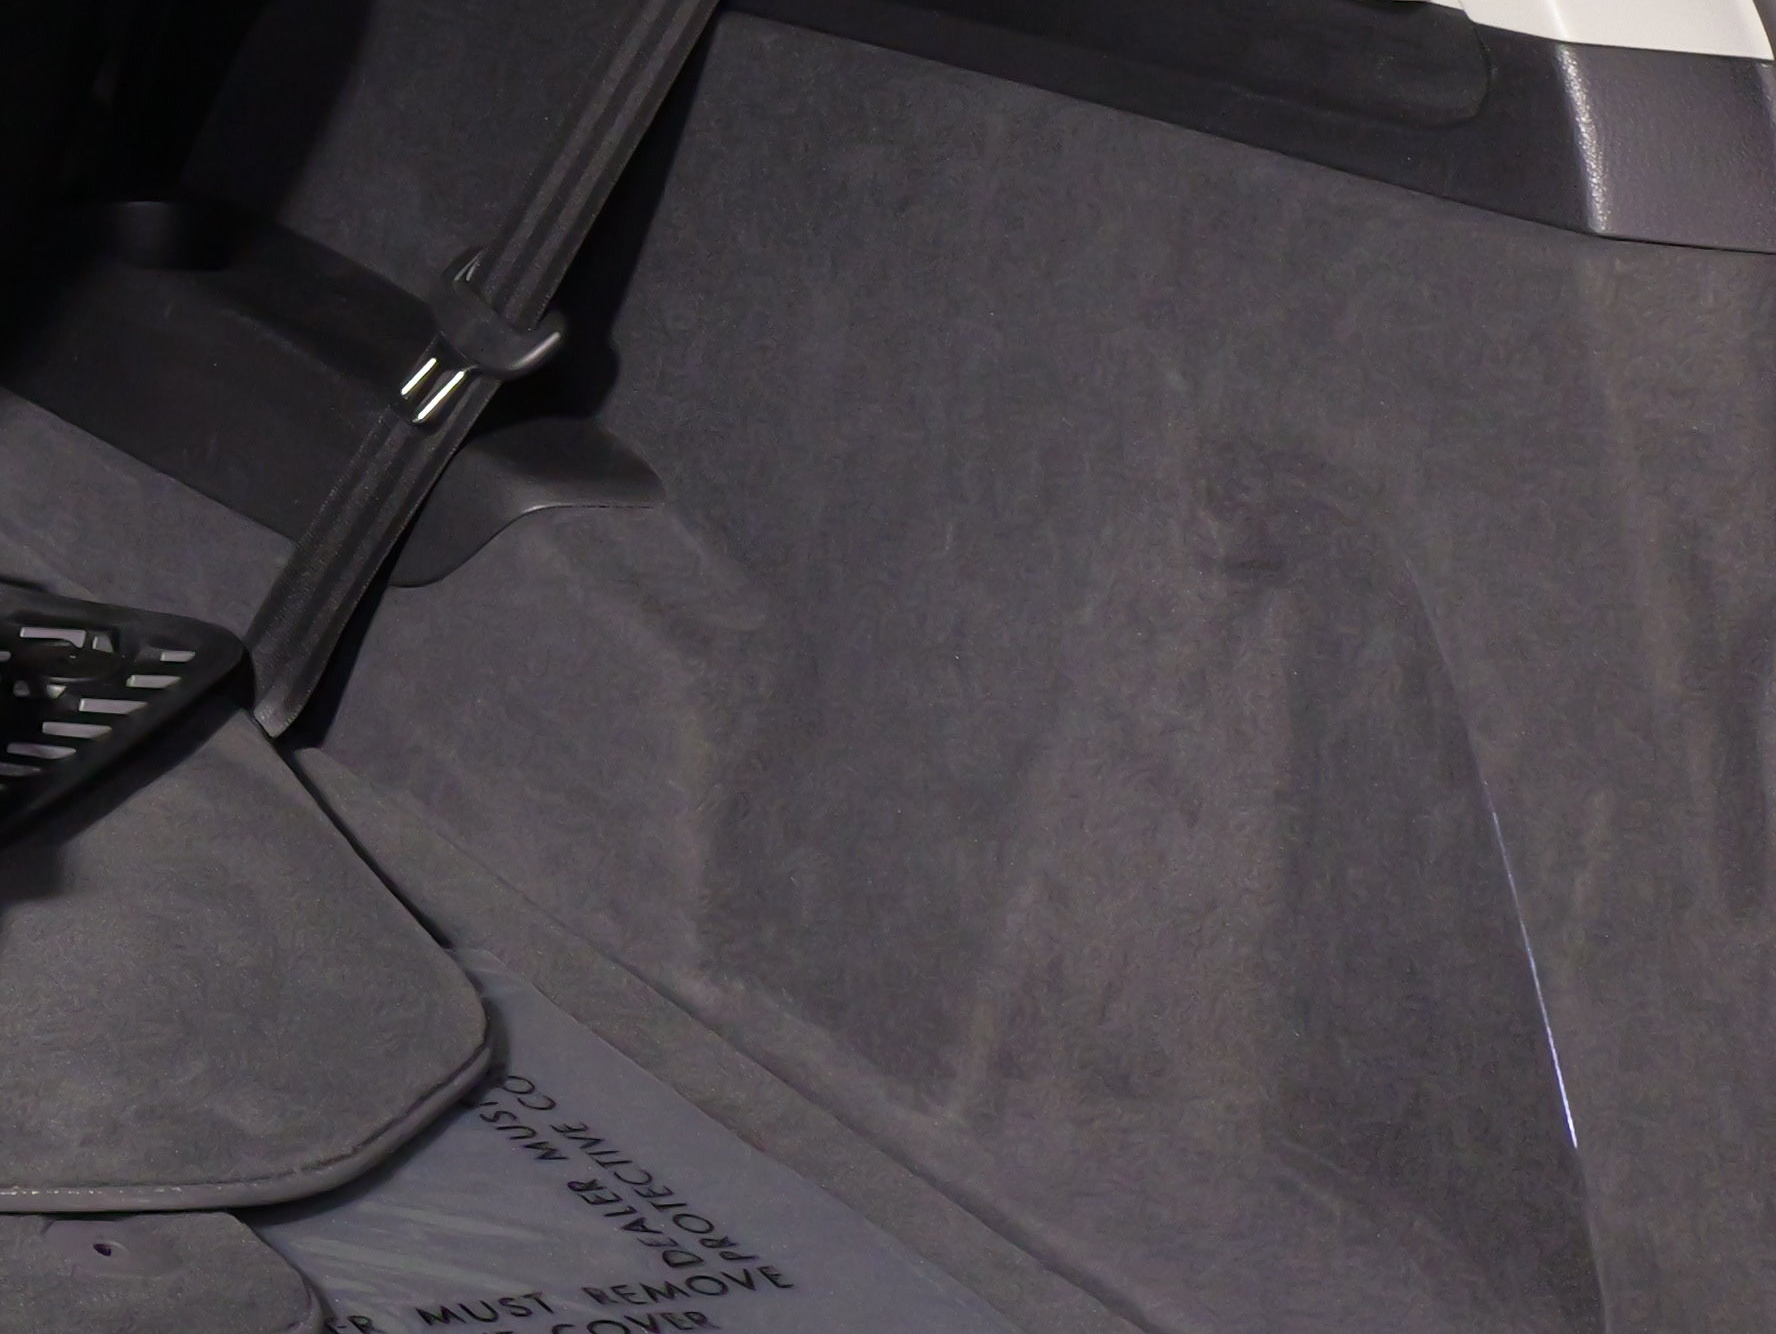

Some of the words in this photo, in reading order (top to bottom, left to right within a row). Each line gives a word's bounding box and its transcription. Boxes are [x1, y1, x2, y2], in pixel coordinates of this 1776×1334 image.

[551, 1121, 760, 1261] PROTECTIVE
[567, 1178, 704, 1269] DEALER
[416, 1290, 556, 1328] MUST
[582, 1266, 794, 1310] REMOVE
